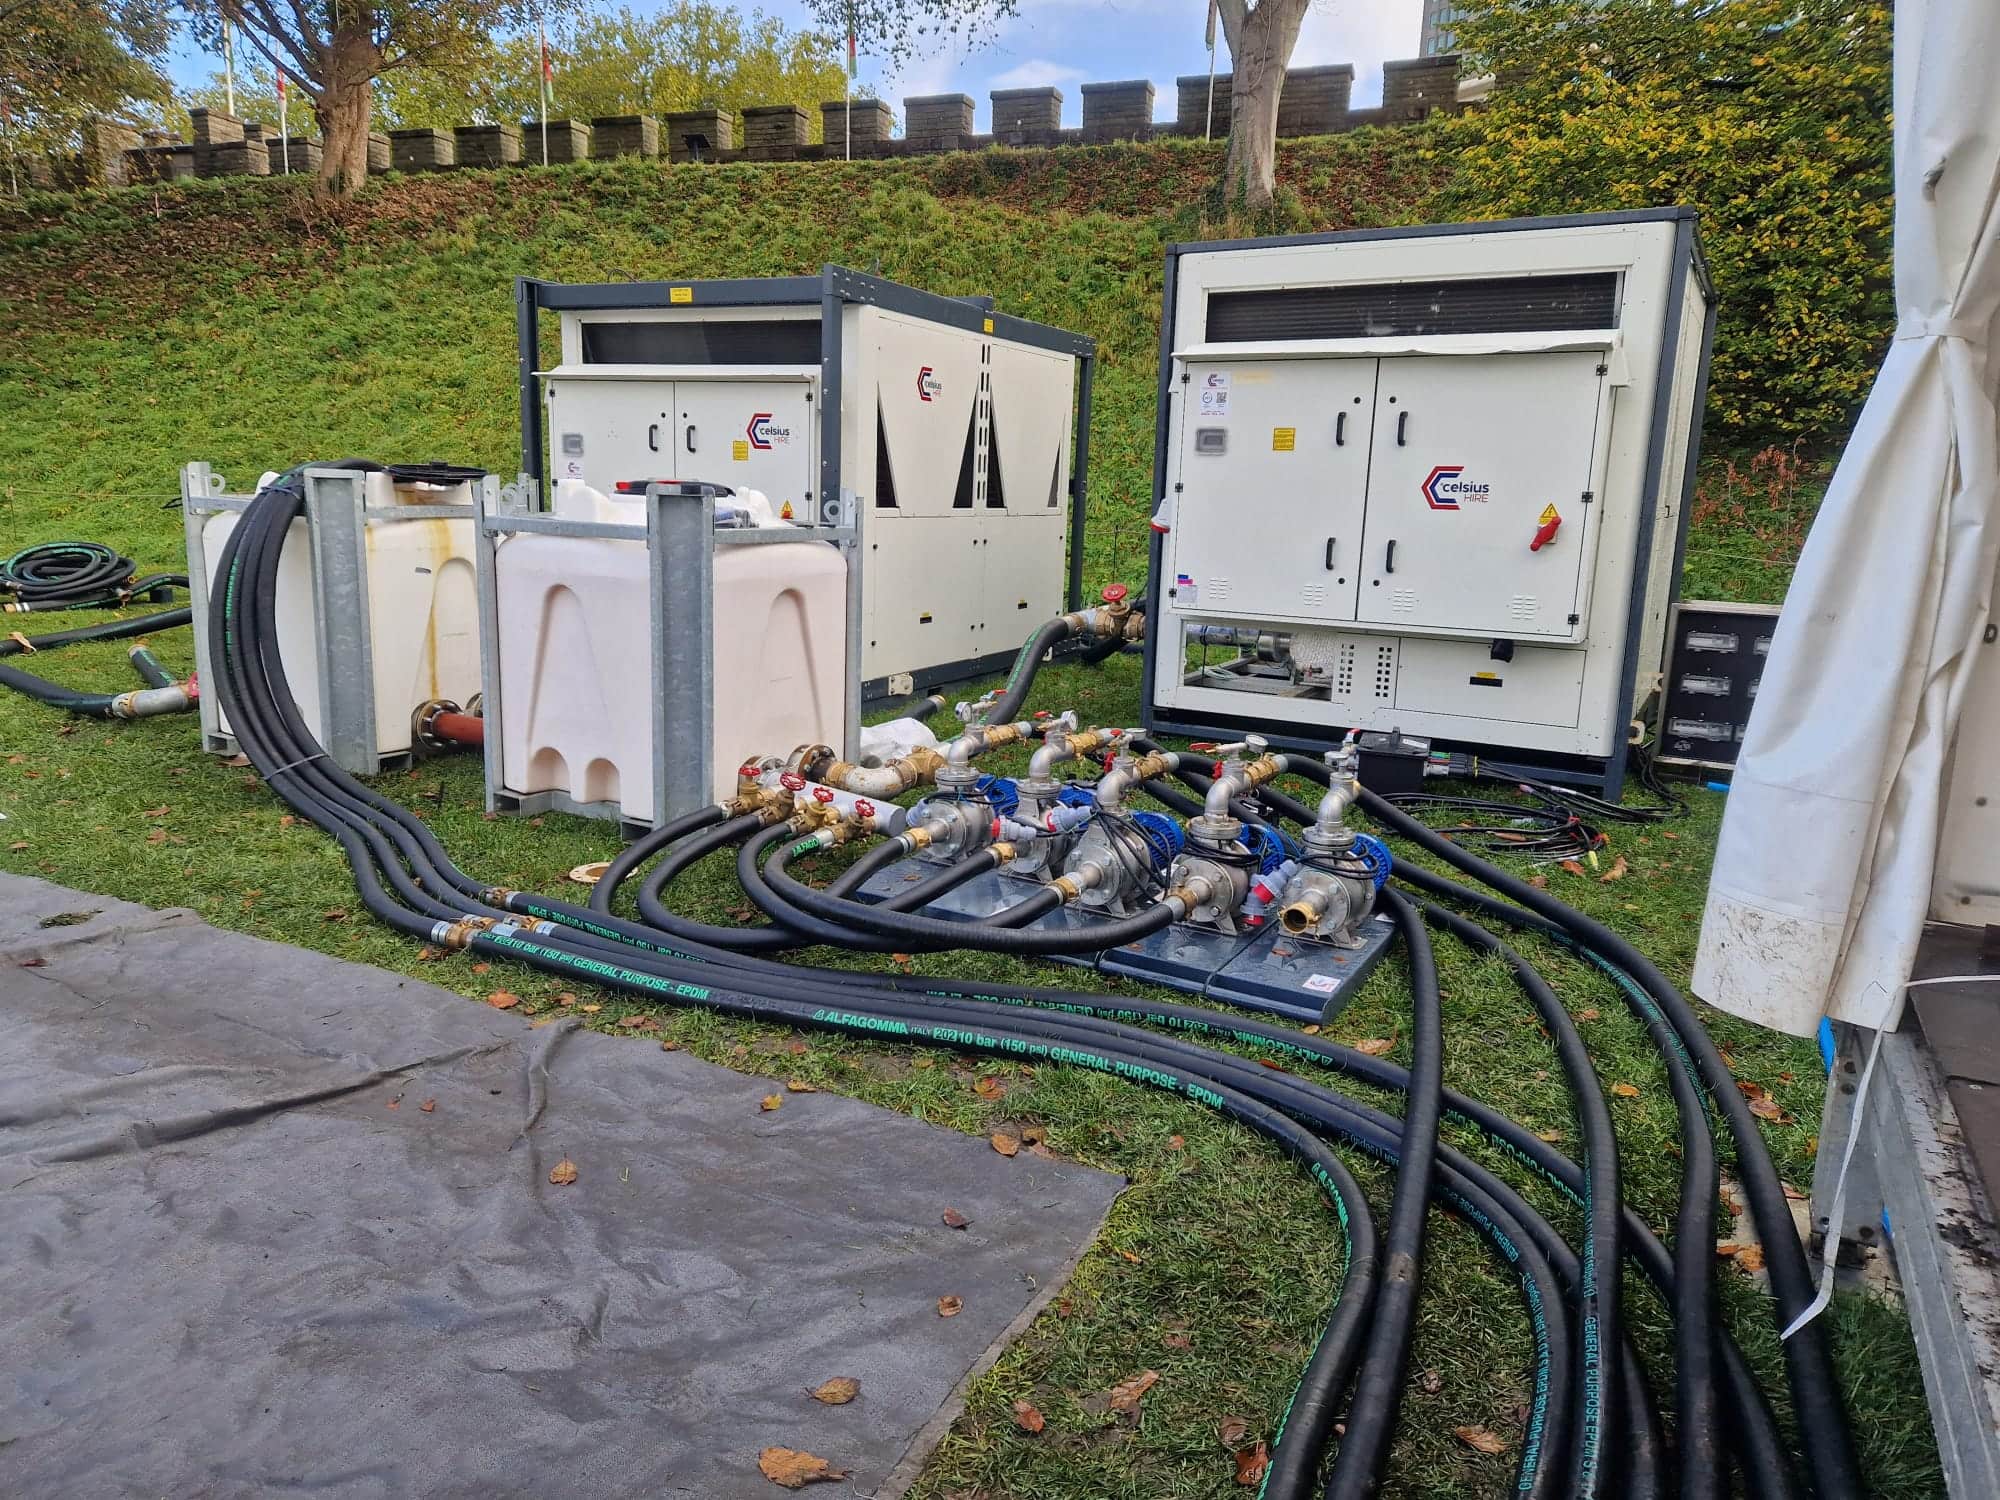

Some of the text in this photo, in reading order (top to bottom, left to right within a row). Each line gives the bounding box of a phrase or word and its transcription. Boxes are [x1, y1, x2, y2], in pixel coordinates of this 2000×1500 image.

[1464, 493, 1489, 503] HIRE
[573, 958, 619, 979] GENERAL
[619, 967, 671, 991] PURPOSE
[676, 984, 710, 1000] EPDM
[824, 1011, 909, 1035] ALFAGOMMA
[911, 1026, 931, 1036] ITALY
[976, 1033, 997, 1048] bar
[1001, 1038, 1026, 1053] (150
[1029, 1043, 1048, 1057] psi)
[1050, 1047, 1112, 1073] GENERAL
[1115, 1061, 1178, 1091] PURPOSE
[1187, 1083, 1226, 1110] EPDM
[1584, 1316, 1598, 1367] GENERAL
[1537, 1367, 1550, 1394] EPDM
[1586, 1368, 1601, 1424] PURPOSE
[1529, 1393, 1547, 1440] PURPOSE
[1584, 1425, 1600, 1458] EPDM
[1519, 1440, 1540, 1491] GENERAL
